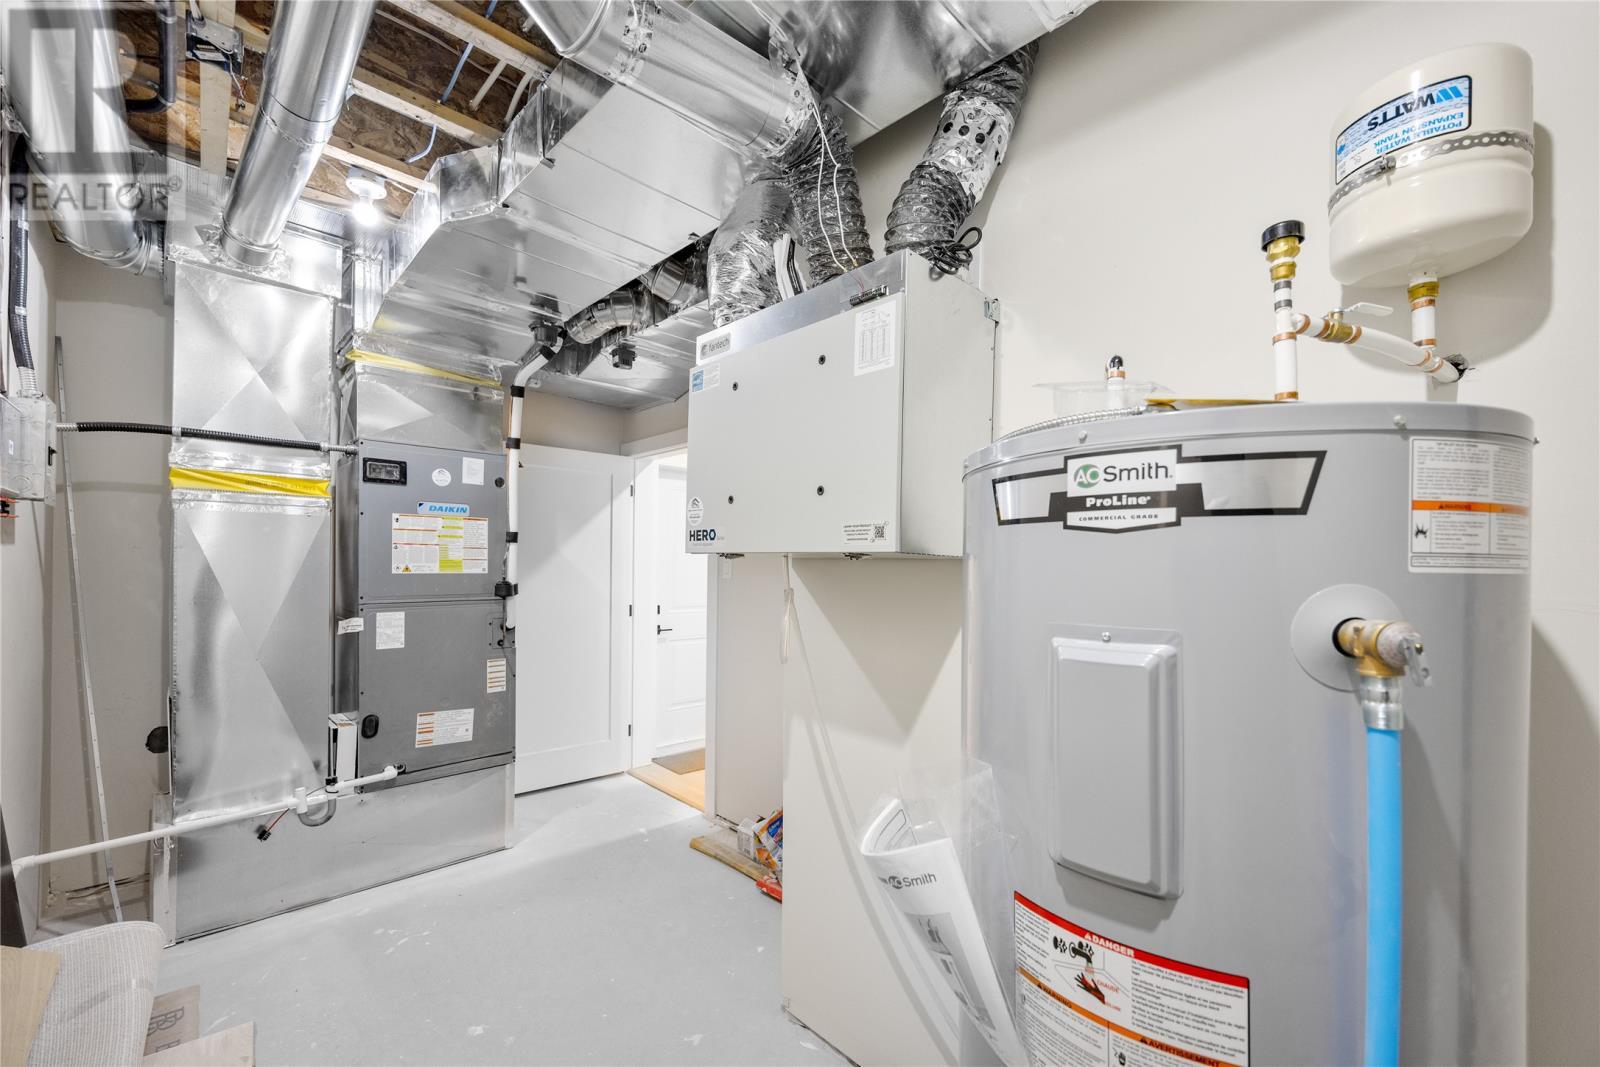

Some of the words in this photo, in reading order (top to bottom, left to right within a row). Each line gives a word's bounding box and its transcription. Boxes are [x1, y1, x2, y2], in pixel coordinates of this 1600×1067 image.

[1367, 92, 1436, 131] WATTS
[1374, 133, 1399, 147] TANK
[1375, 136, 1411, 154] WATER
[1103, 462, 1168, 482] Smith
[1086, 495, 1148, 507] ProLine
[429, 505, 467, 513] DAIKIN
[689, 529, 716, 542] HERO
[902, 873, 937, 887] Smith
[1091, 935, 1135, 958] DANGER
